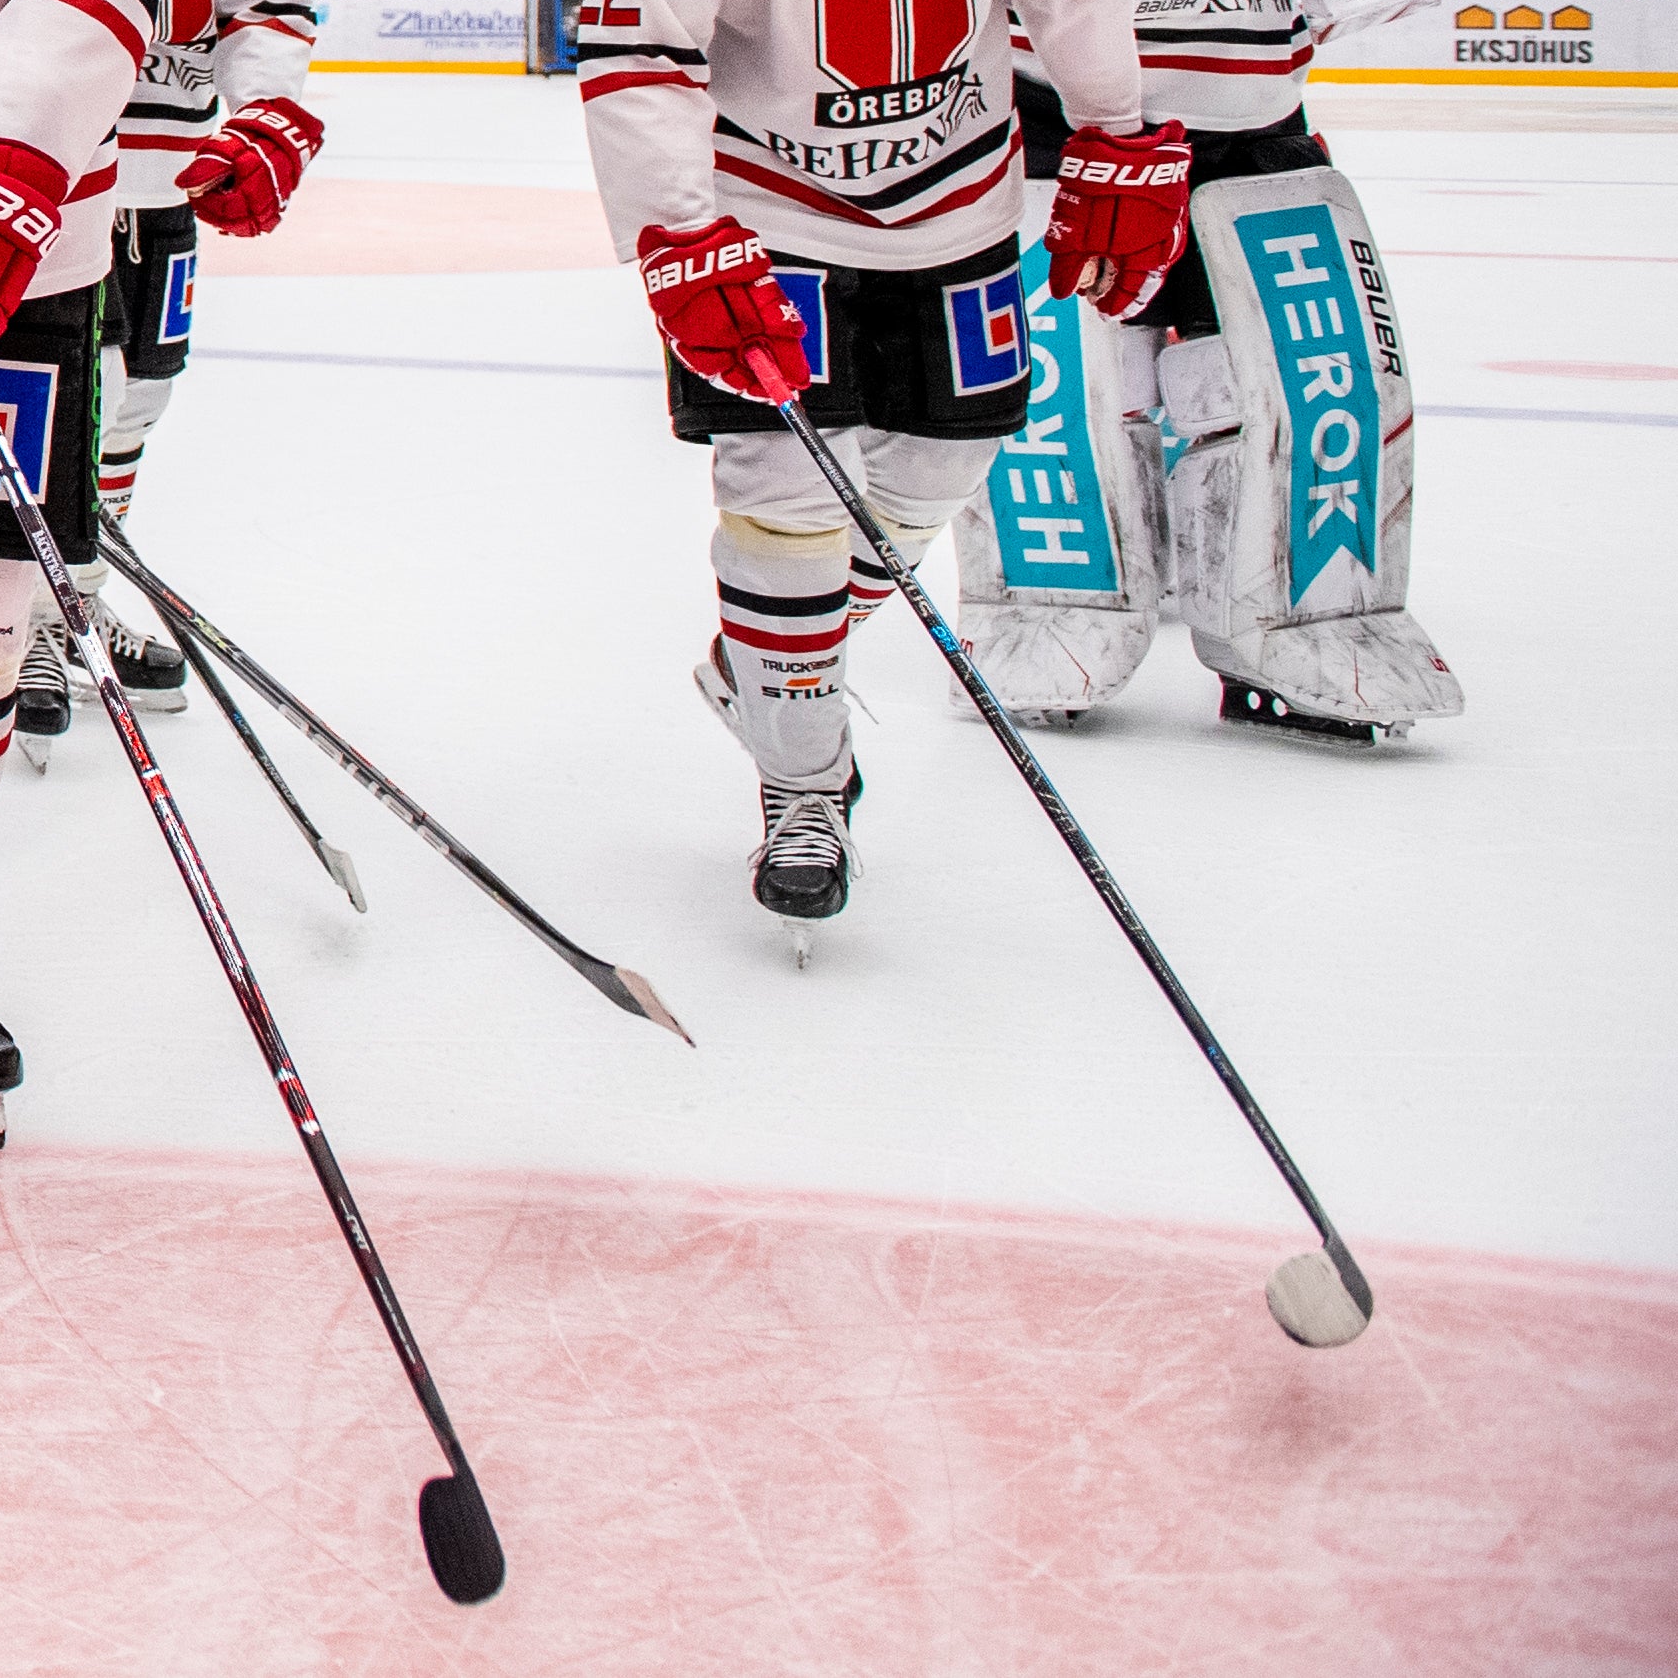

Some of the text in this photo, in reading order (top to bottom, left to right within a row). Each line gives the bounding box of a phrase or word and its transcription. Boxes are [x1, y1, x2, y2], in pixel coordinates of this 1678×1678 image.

[1454, 34, 1594, 64] EKSJÖHUS
[827, 72, 963, 124] ÖREBRO
[1058, 152, 1190, 187] BAUER
[645, 237, 767, 296] BAUER
[1349, 238, 1404, 377] BAUER
[1262, 232, 1363, 539] HEROK
[760, 683, 841, 700] STILL
